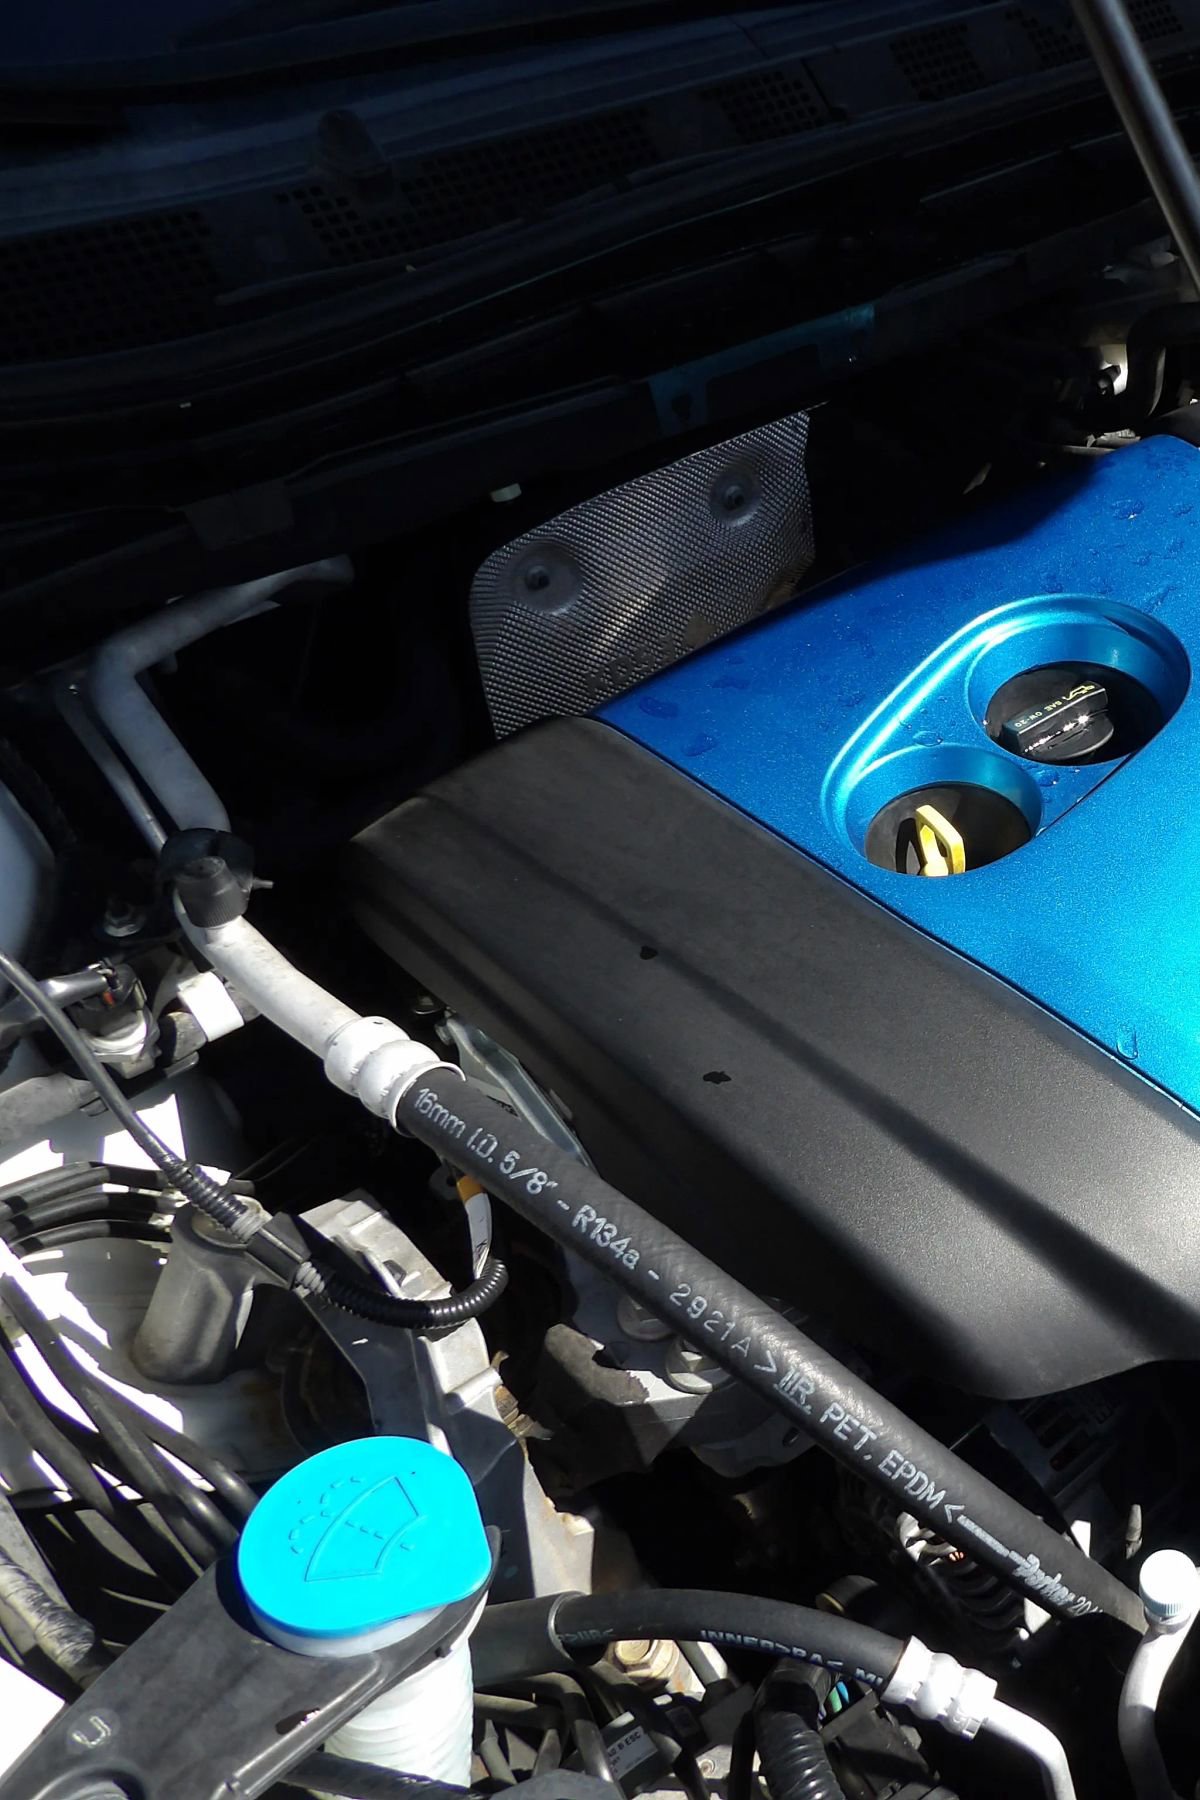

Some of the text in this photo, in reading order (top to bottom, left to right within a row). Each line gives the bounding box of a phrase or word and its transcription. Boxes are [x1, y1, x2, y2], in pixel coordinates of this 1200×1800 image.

[1015, 700, 1063, 728] SAE 0W-20
[414, 1088, 465, 1140] 16mm
[466, 1127, 498, 1163] I.D.
[571, 1203, 641, 1270] R134a
